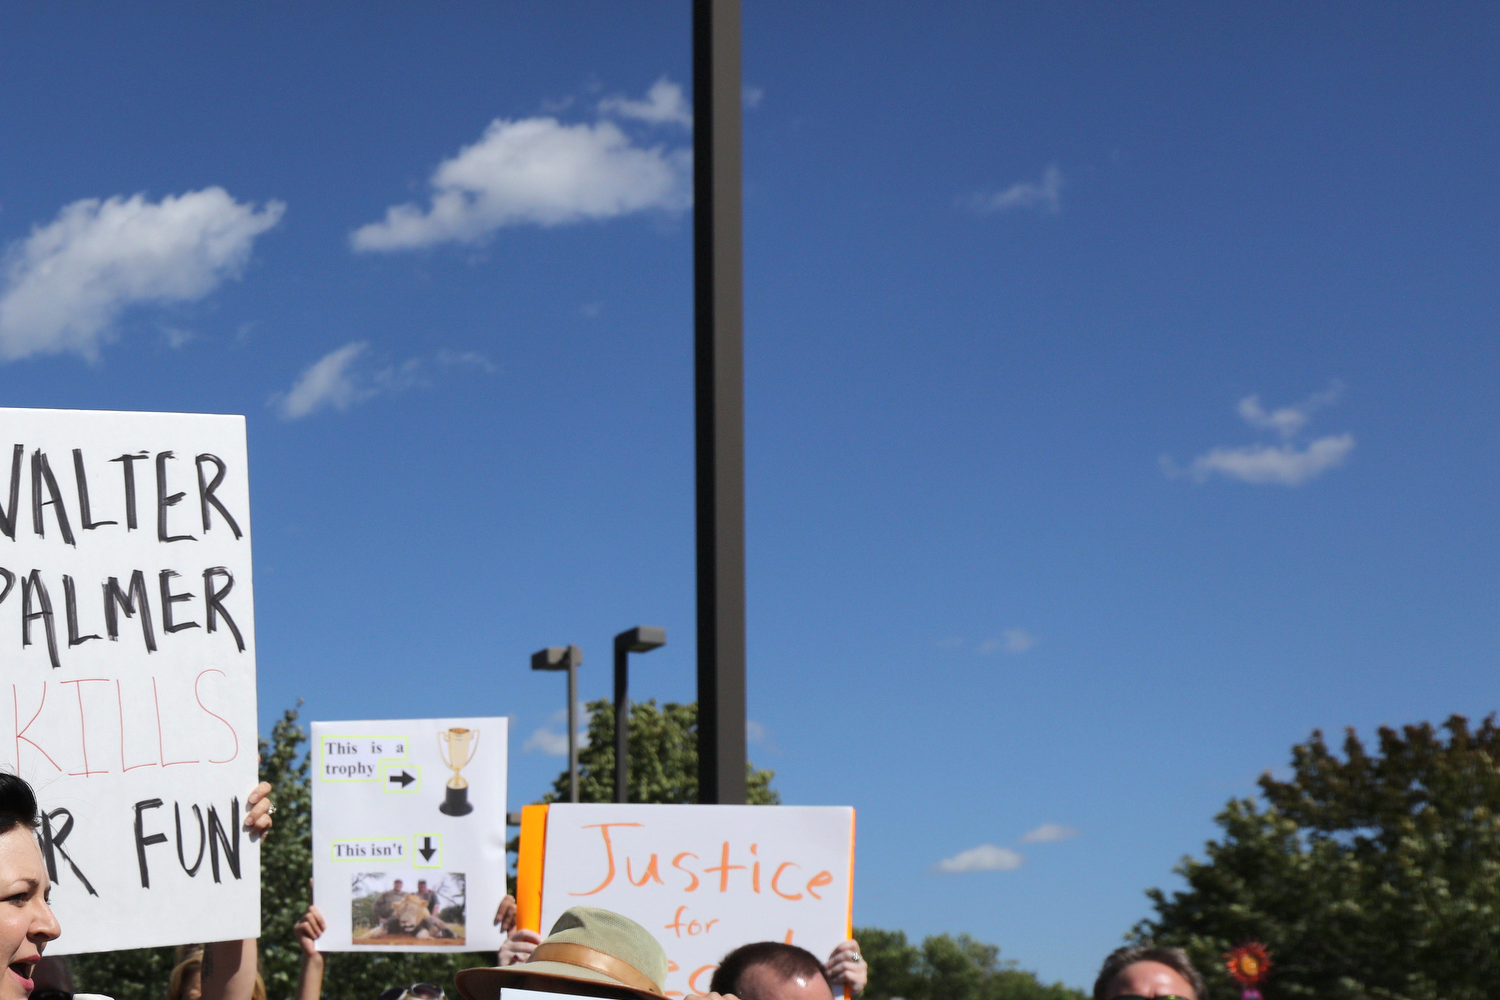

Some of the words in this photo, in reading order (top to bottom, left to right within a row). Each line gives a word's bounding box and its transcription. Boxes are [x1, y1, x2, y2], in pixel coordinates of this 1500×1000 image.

[11, 668, 239, 778] KILLS
[325, 742, 358, 755] This
[371, 741, 383, 754] is
[396, 743, 405, 753] a
[325, 761, 375, 777] trophy
[134, 795, 242, 889] FUN
[333, 844, 366, 857] This
[371, 843, 404, 856] isn't
[568, 822, 834, 900] Justice
[664, 905, 720, 938] for
